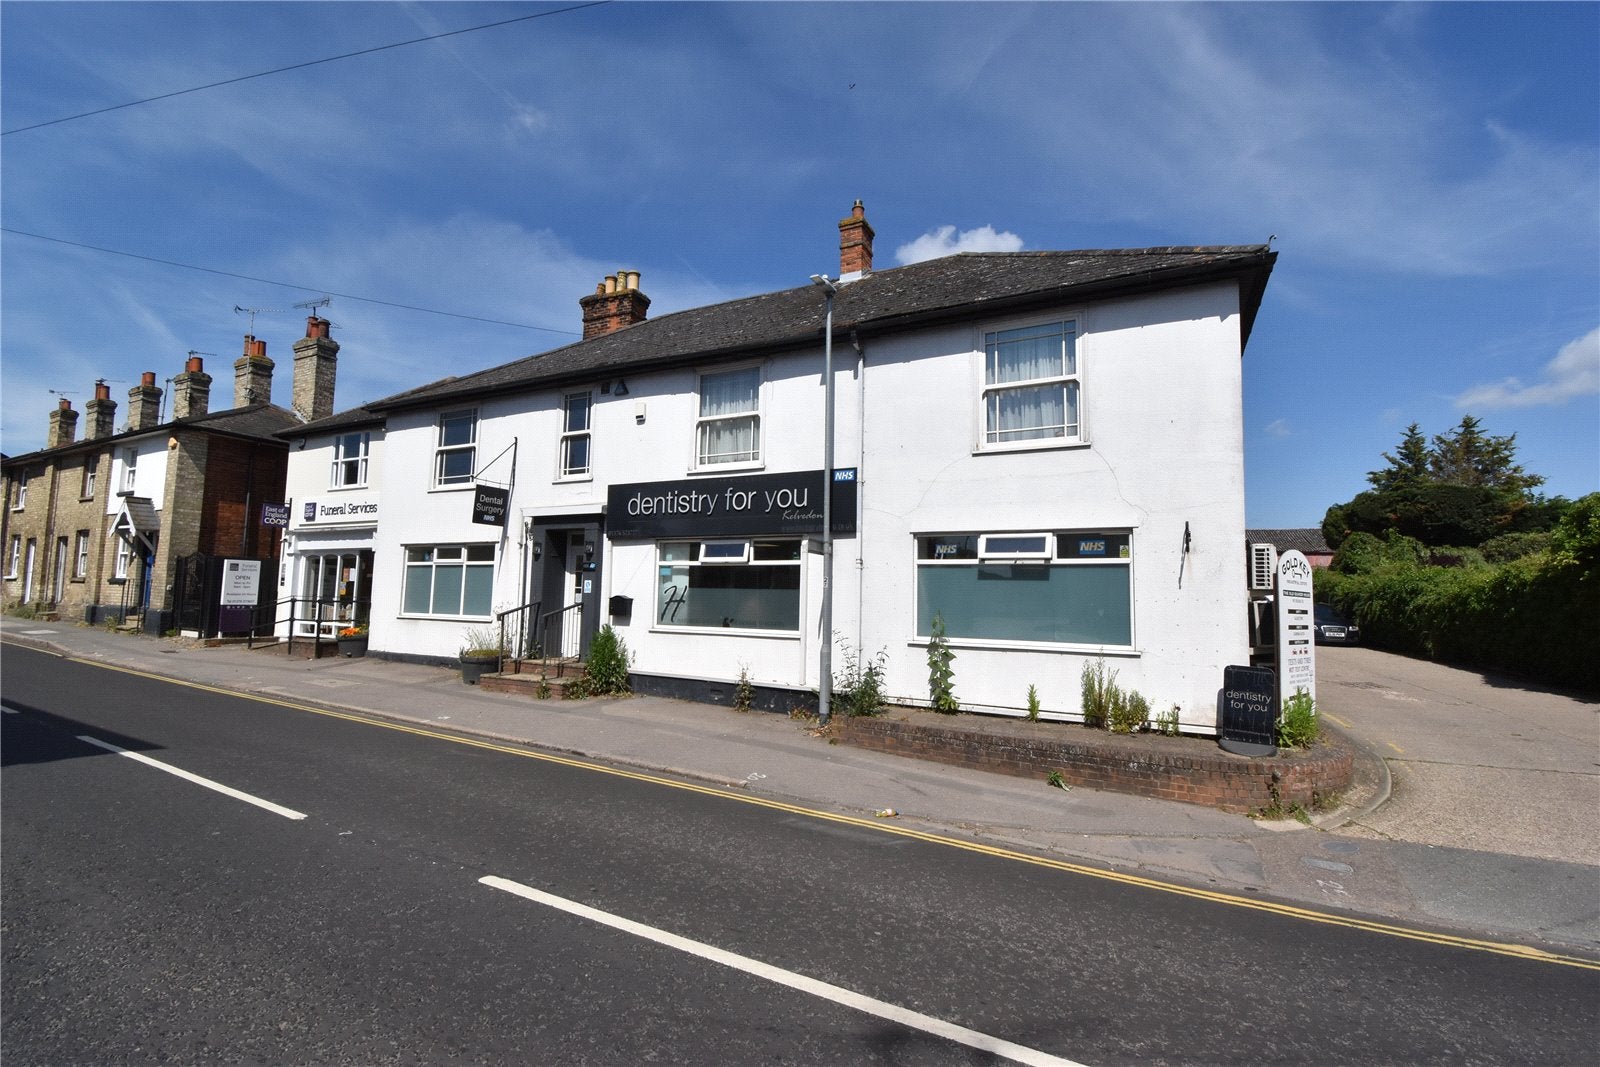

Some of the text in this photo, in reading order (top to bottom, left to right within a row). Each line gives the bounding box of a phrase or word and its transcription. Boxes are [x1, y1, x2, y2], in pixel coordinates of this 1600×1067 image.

[834, 472, 854, 480] NHS
[479, 494, 503, 505] Dental
[627, 487, 808, 516] dentistry for you
[320, 503, 346, 516] Funeral
[347, 501, 378, 515] Services
[475, 503, 504, 516] Surgery
[483, 514, 495, 522] NHS
[781, 509, 824, 521] Kelvedon
[935, 544, 957, 554] NHS
[1079, 541, 1105, 551] NHS
[1282, 557, 1310, 578] GOLD KEY
[1226, 688, 1272, 704] dentistry
[1231, 701, 1268, 712] for you
